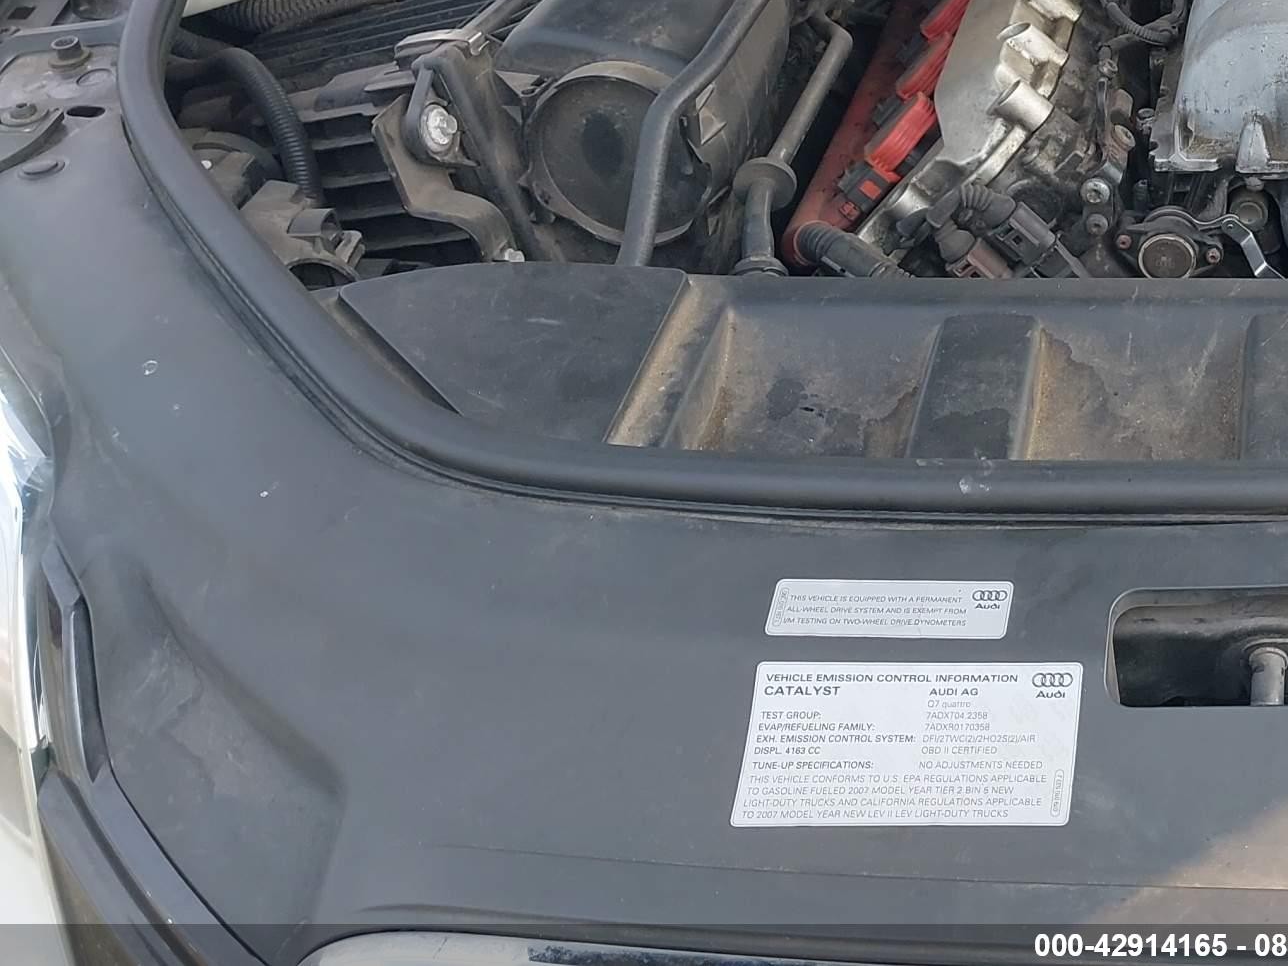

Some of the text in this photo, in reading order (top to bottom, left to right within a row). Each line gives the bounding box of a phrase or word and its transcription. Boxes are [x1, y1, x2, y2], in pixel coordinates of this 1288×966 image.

[766, 673, 1019, 683] VEHICLE EMISSION CONTROL INFORMATION
[764, 685, 841, 696] CATALYST
[929, 687, 979, 696] AUDI AG
[1035, 690, 1066, 699] Audi
[927, 700, 971, 710] Q7 quattro
[760, 711, 822, 720] TEST GROUP:
[758, 723, 876, 732] EVAP/REFUELING FAMILY:
[756, 734, 916, 743] EXH. EMISSION CONTROL SYSTEM:
[785, 746, 806, 755] 4163
[807, 746, 821, 755] CC
[921, 746, 998, 754] OBD II CERTIFIED
[752, 761, 874, 770] TUNE-UP SPECIFICATIONS:
[918, 761, 1043, 769] NO ADJUSTMENTS NEEDED
[749, 775, 770, 784] THIS
[772, 775, 809, 784] VEHICLE
[812, 775, 865, 783] CONFORMS
[868, 775, 881, 783] TO
[903, 774, 921, 783] EPA
[923, 774, 989, 783] REGULATIONS
[990, 774, 1047, 783] APPLICABLE
[747, 787, 760, 795] TO
[761, 787, 809, 795] GASOLINE
[810, 787, 846, 795] FUELED
[848, 787, 869, 795] 2007
[871, 787, 905, 795] MODEL
[908, 786, 932, 794] YEAR
[935, 786, 954, 794] TIER
[956, 786, 962, 794] 2
[965, 786, 980, 794] BIN
[991, 786, 1015, 794] NEW
[743, 798, 1042, 807] LIGHT-DUTY TRUCKS AND CALIFORNIA REGULATIONS APPLICABLE
[742, 809, 1009, 819] TO 2007 MODEL YEAR NEW LEV II LEV LIGHT-DUTY TRUCKS
